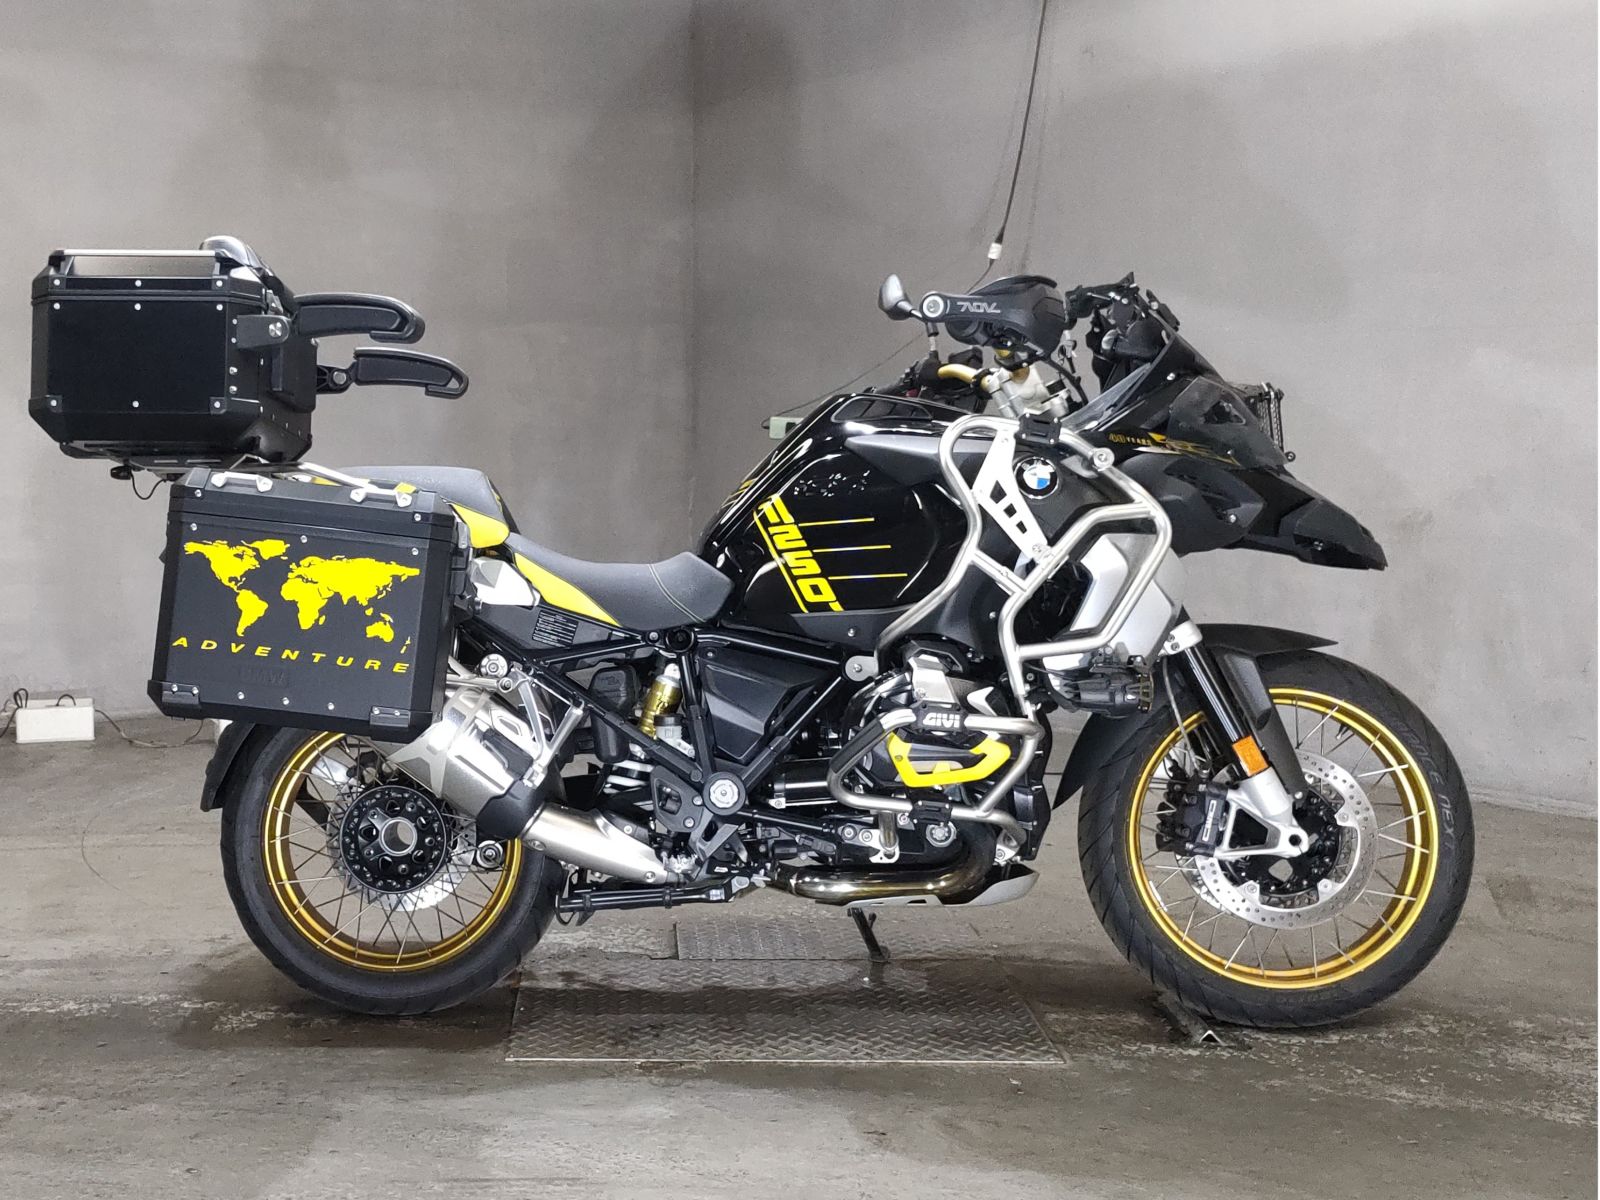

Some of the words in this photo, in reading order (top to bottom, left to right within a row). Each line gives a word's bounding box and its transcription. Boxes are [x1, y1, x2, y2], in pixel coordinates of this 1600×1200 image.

[957, 301, 1001, 313] ADV
[172, 636, 410, 674] ADVENTURE
[922, 712, 960, 728] GIVI
